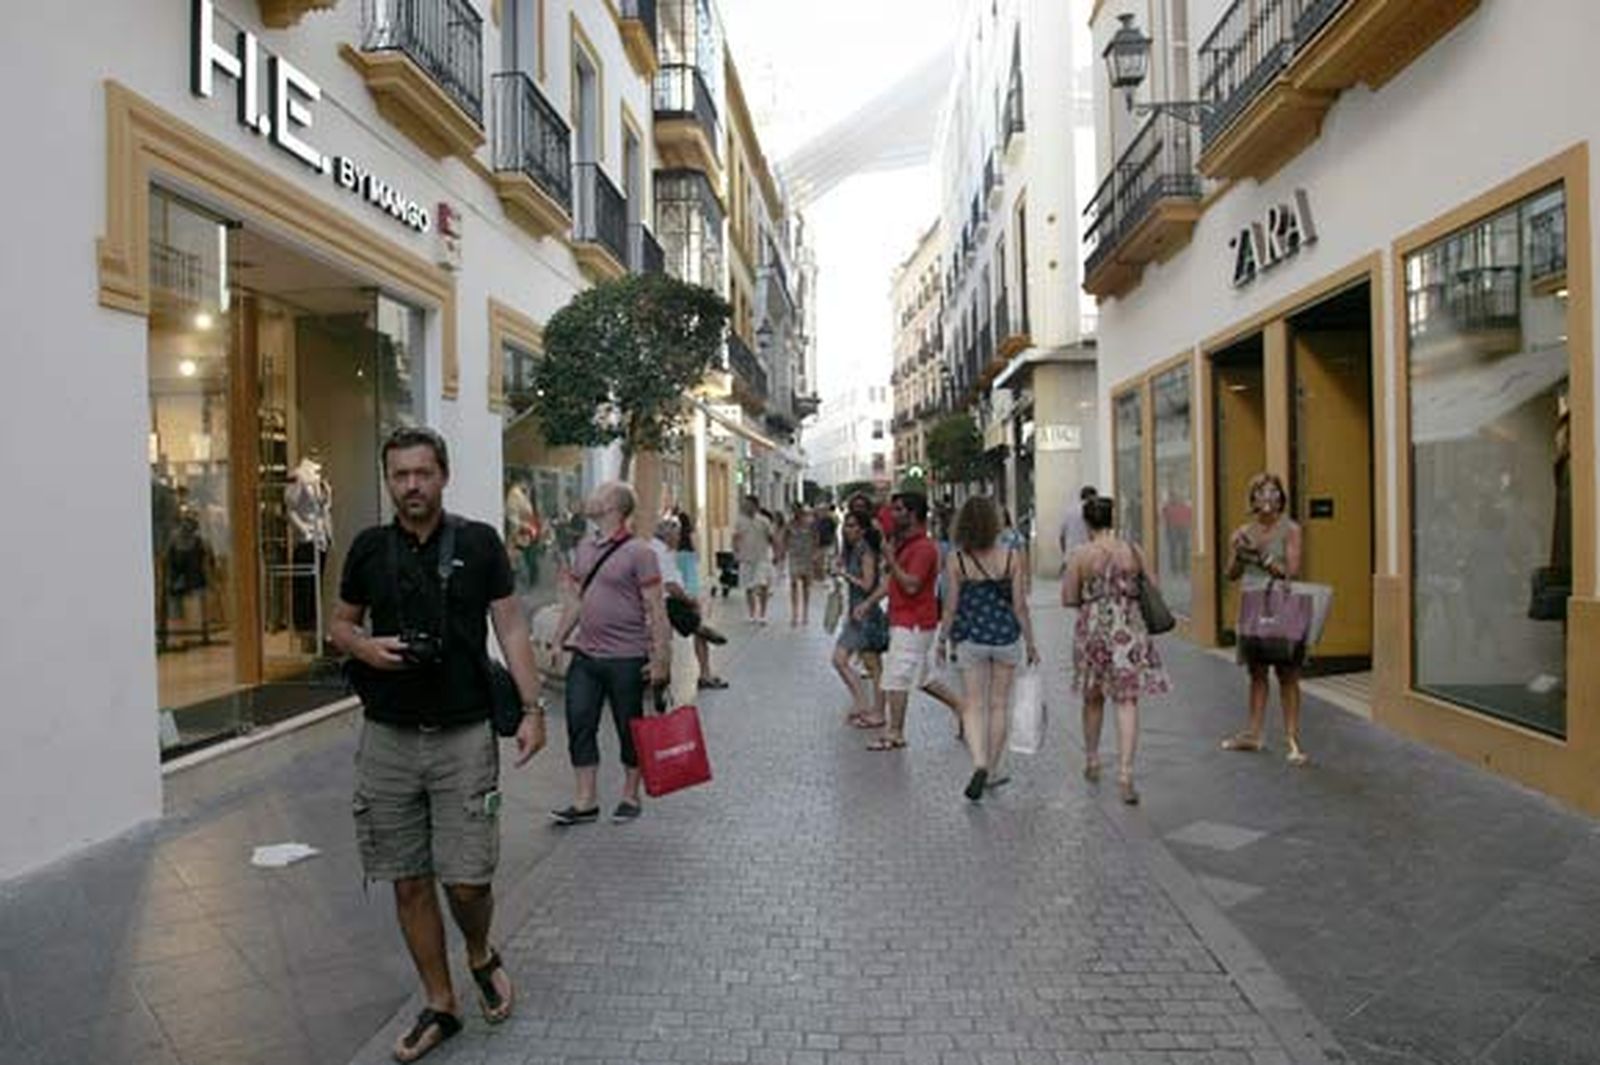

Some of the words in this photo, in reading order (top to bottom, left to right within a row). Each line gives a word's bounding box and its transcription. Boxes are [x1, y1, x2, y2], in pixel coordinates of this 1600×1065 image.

[333, 156, 369, 193] BY
[363, 174, 431, 233] MANGO
[1229, 187, 1318, 288] ZARA
